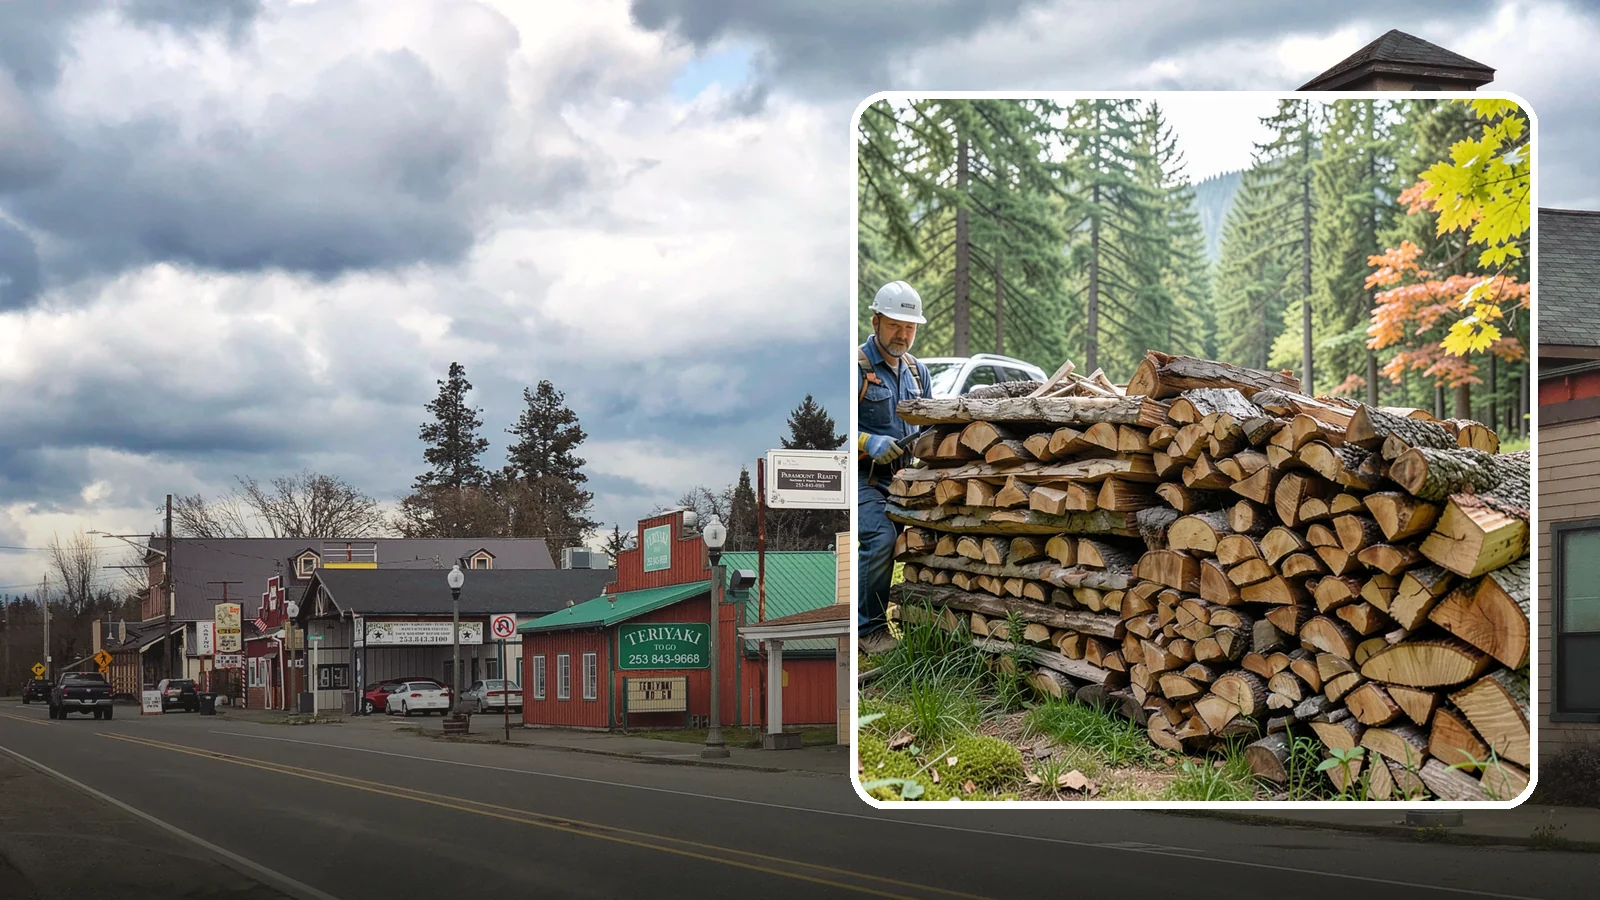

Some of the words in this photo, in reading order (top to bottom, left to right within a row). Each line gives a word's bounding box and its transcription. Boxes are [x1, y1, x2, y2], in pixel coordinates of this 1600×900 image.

[781, 471, 815, 479] PARAMOUNT
[817, 472, 839, 480] REALTY
[625, 627, 702, 646] TERIYAKI
[628, 654, 649, 664] 253
[651, 653, 700, 664] 843-9668
[639, 681, 672, 691] TERIYAKI
